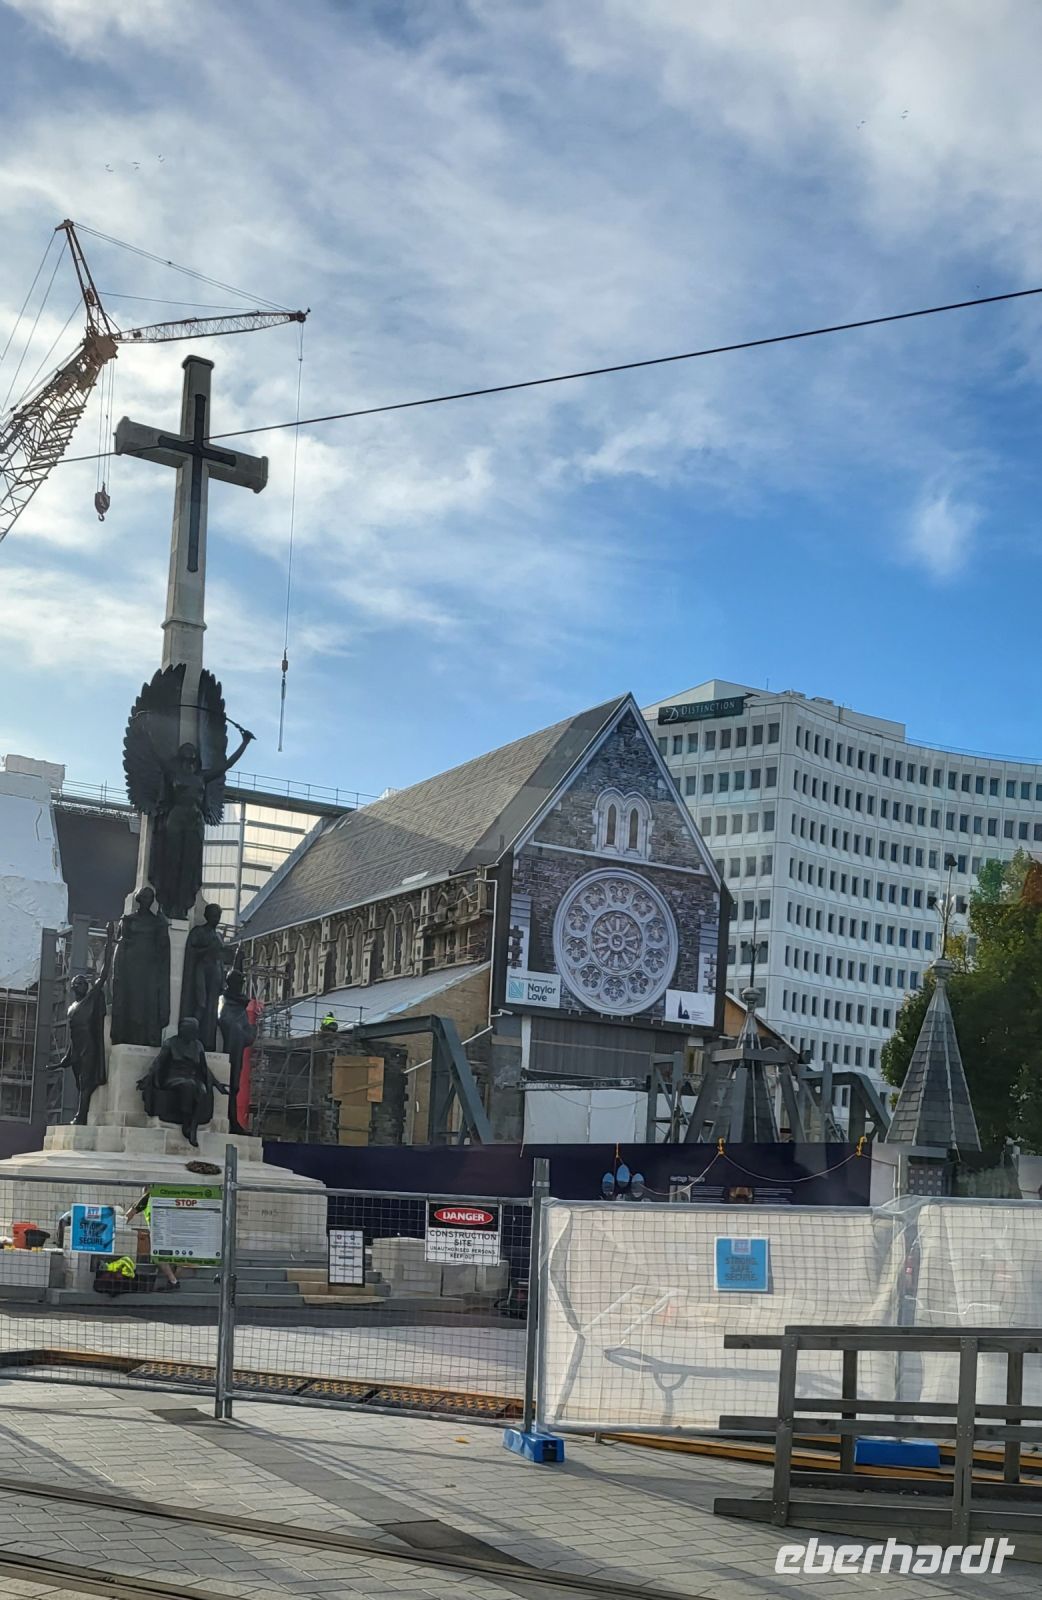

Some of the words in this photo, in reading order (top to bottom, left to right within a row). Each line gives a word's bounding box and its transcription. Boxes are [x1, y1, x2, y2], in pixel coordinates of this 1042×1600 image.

[528, 983, 556, 995] Naylor
[527, 992, 547, 1001] Love
[442, 1211, 485, 1222] DANGER
[429, 1230, 497, 1241] CONSTRUCTION
[454, 1239, 473, 1247] SITE
